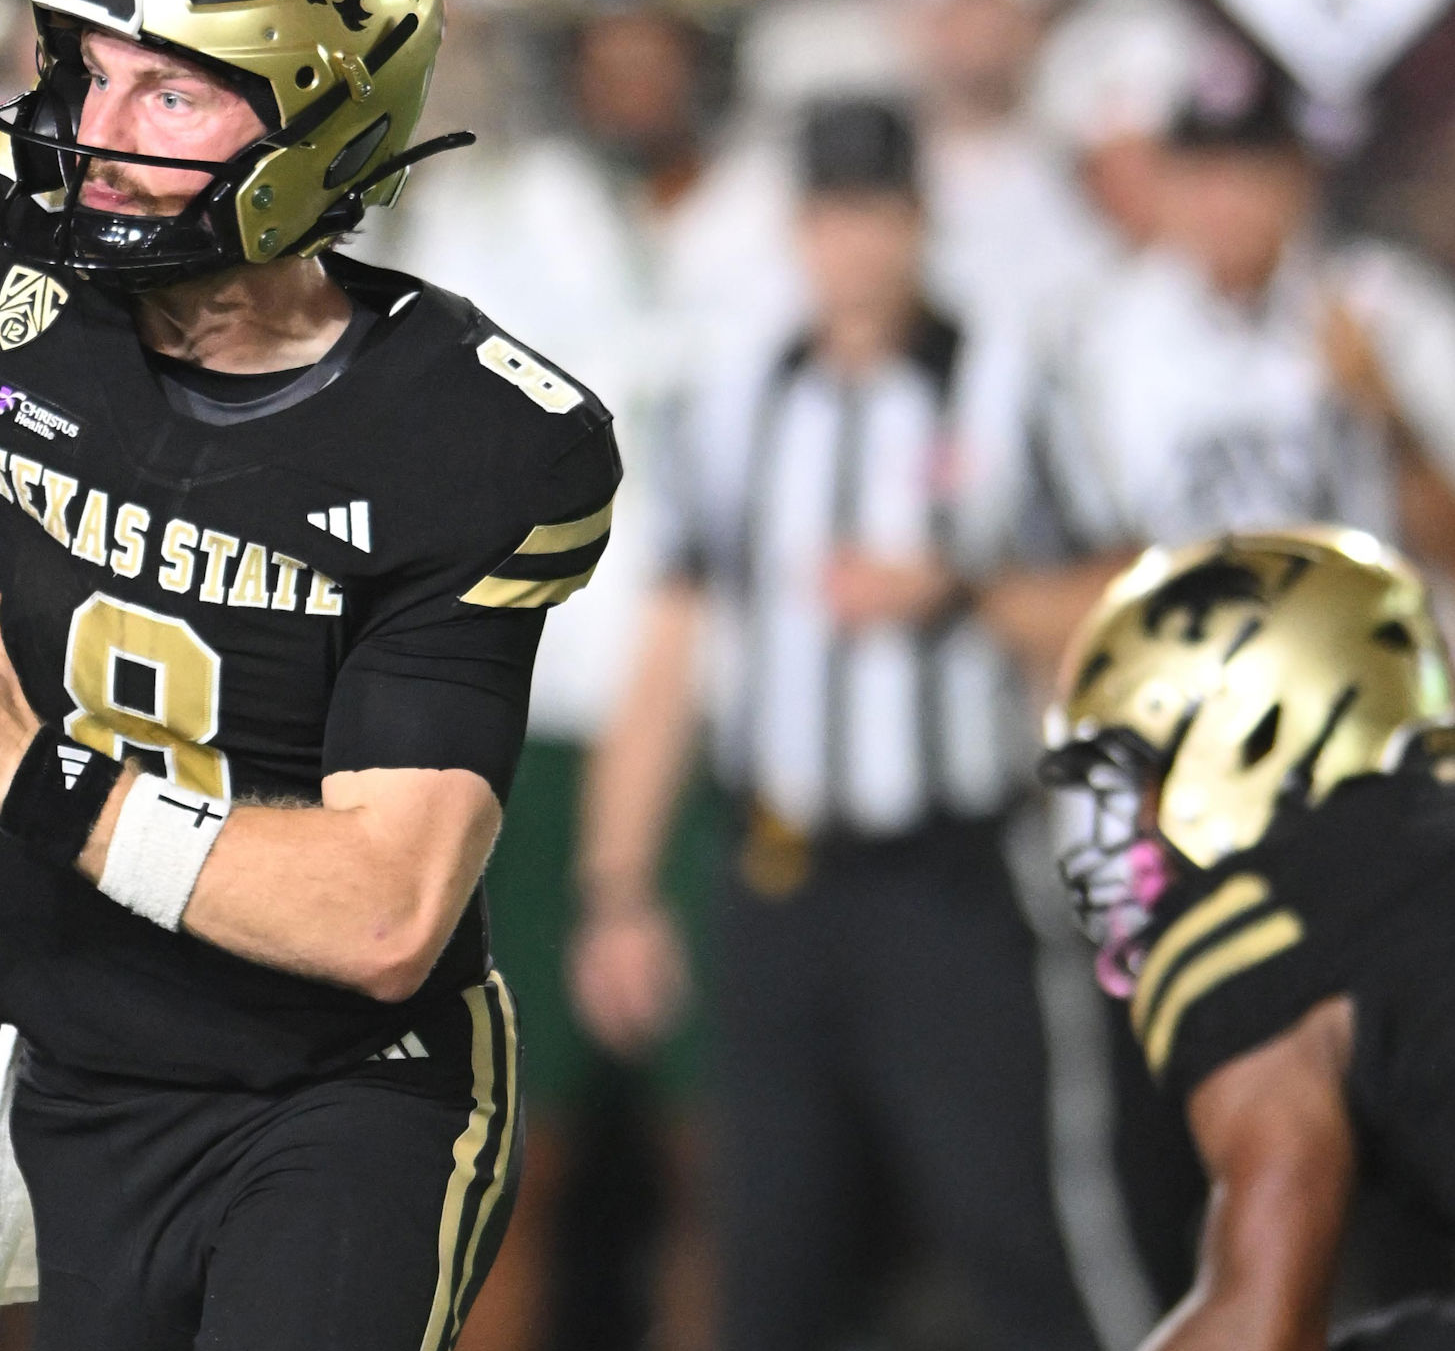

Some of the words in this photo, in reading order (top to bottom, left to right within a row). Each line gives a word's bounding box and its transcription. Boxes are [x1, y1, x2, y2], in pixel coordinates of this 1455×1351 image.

[2, 320, 25, 342] 12
[476, 335, 584, 414] 8
[20, 400, 79, 438] CHRISTUS
[158, 518, 343, 615] STATE
[63, 590, 232, 799] 8
